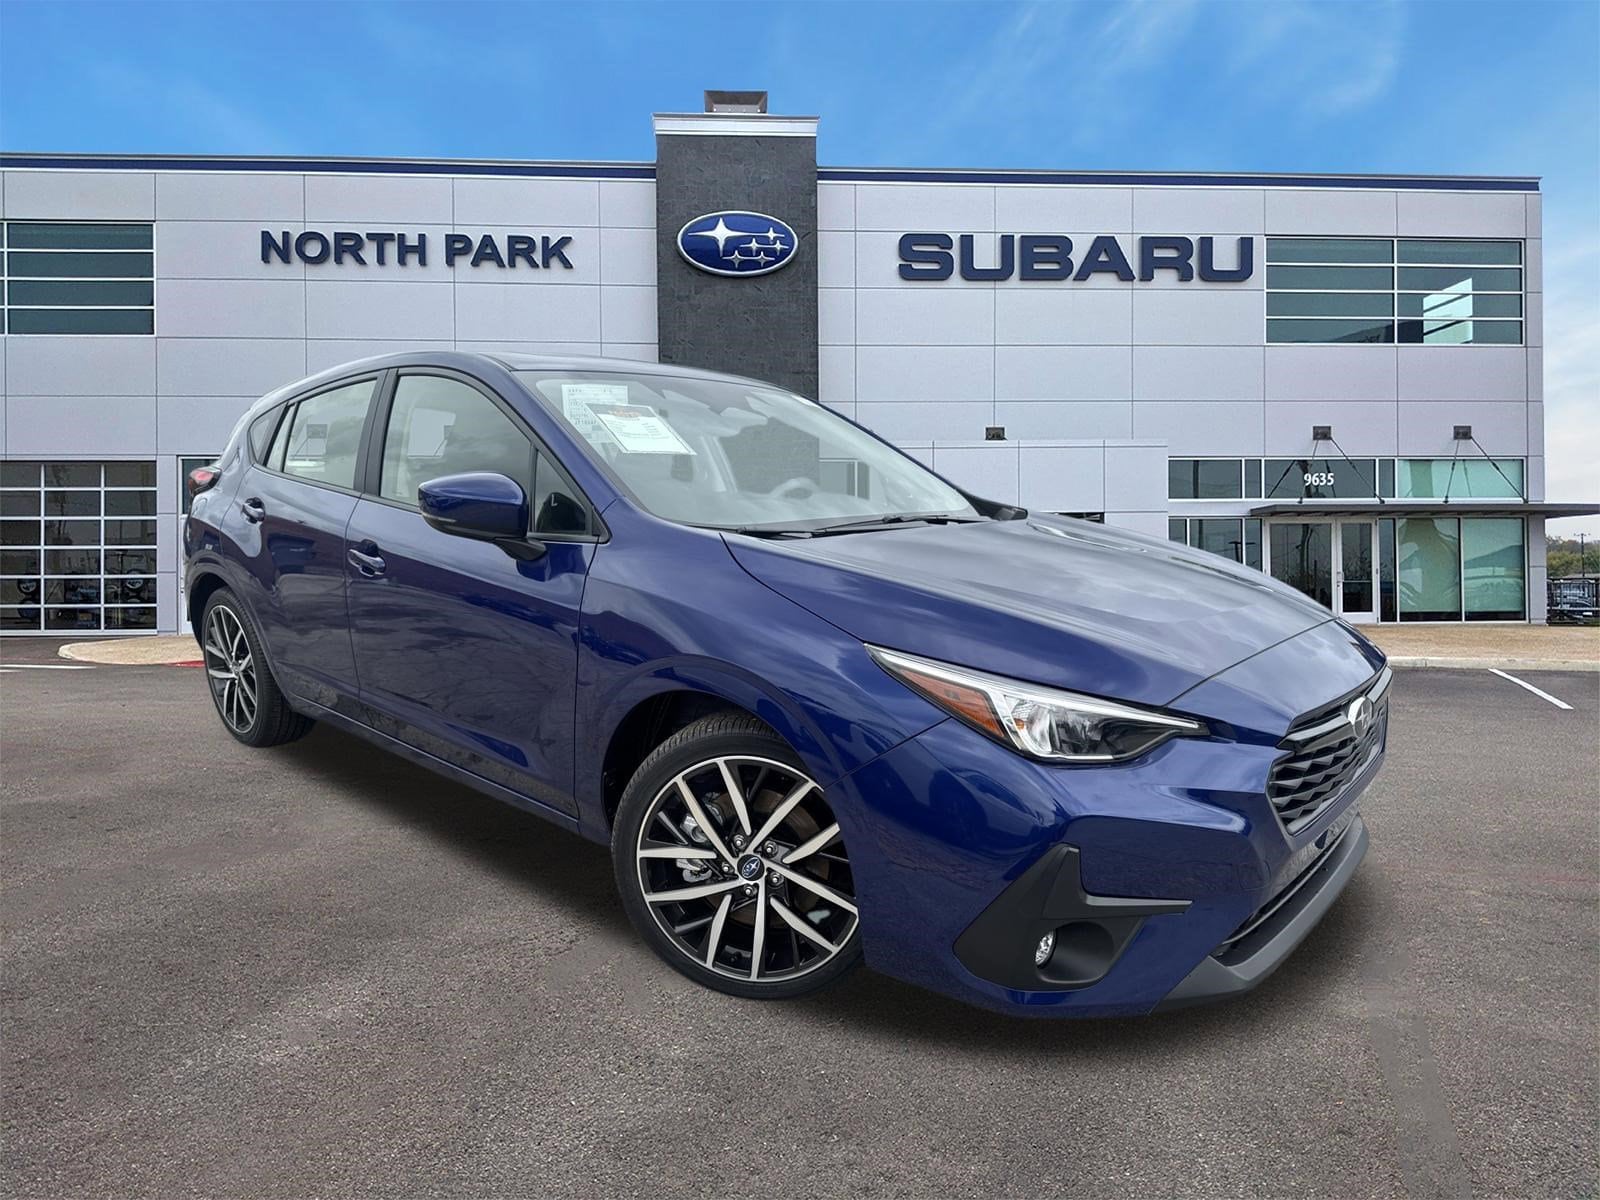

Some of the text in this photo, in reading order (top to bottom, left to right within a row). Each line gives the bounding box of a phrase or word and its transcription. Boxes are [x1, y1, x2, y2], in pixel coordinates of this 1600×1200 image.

[260, 230, 574, 269] NORTH PARK
[898, 233, 1254, 282] SUBARU
[1303, 472, 1335, 486] 9635
